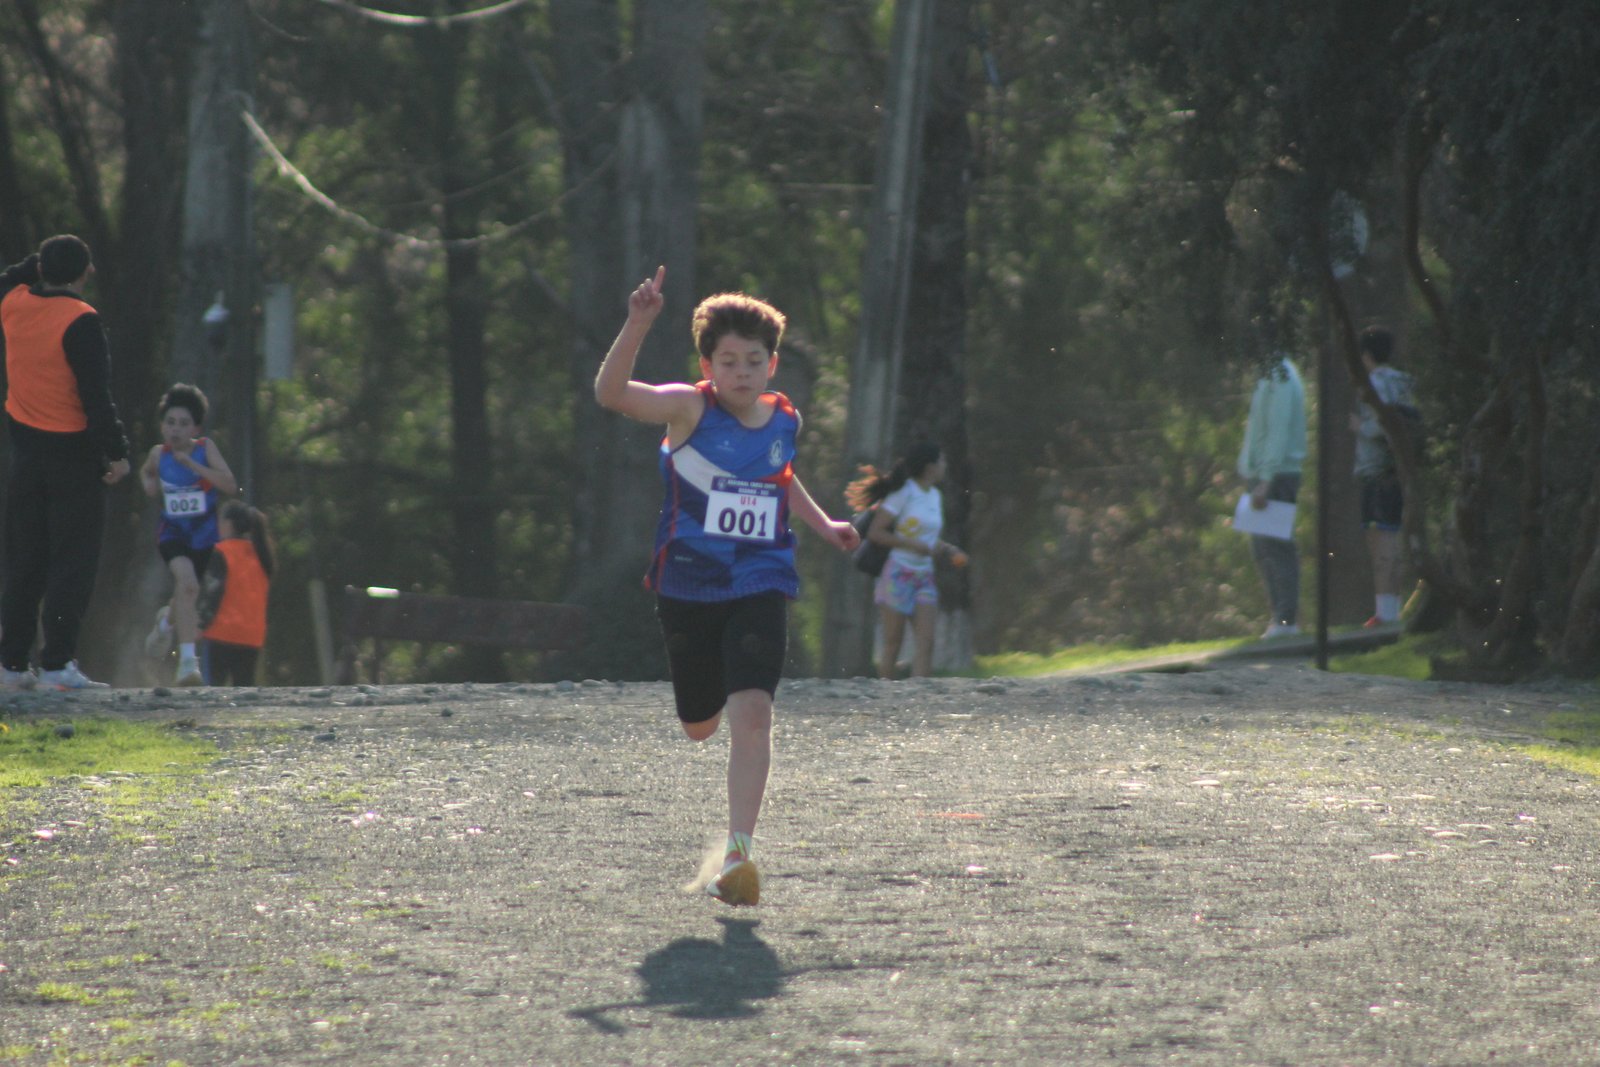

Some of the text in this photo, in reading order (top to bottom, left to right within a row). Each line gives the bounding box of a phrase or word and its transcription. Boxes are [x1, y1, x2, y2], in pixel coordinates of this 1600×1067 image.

[170, 498, 199, 513] 002
[740, 496, 757, 506] U14
[718, 507, 767, 537] 001
